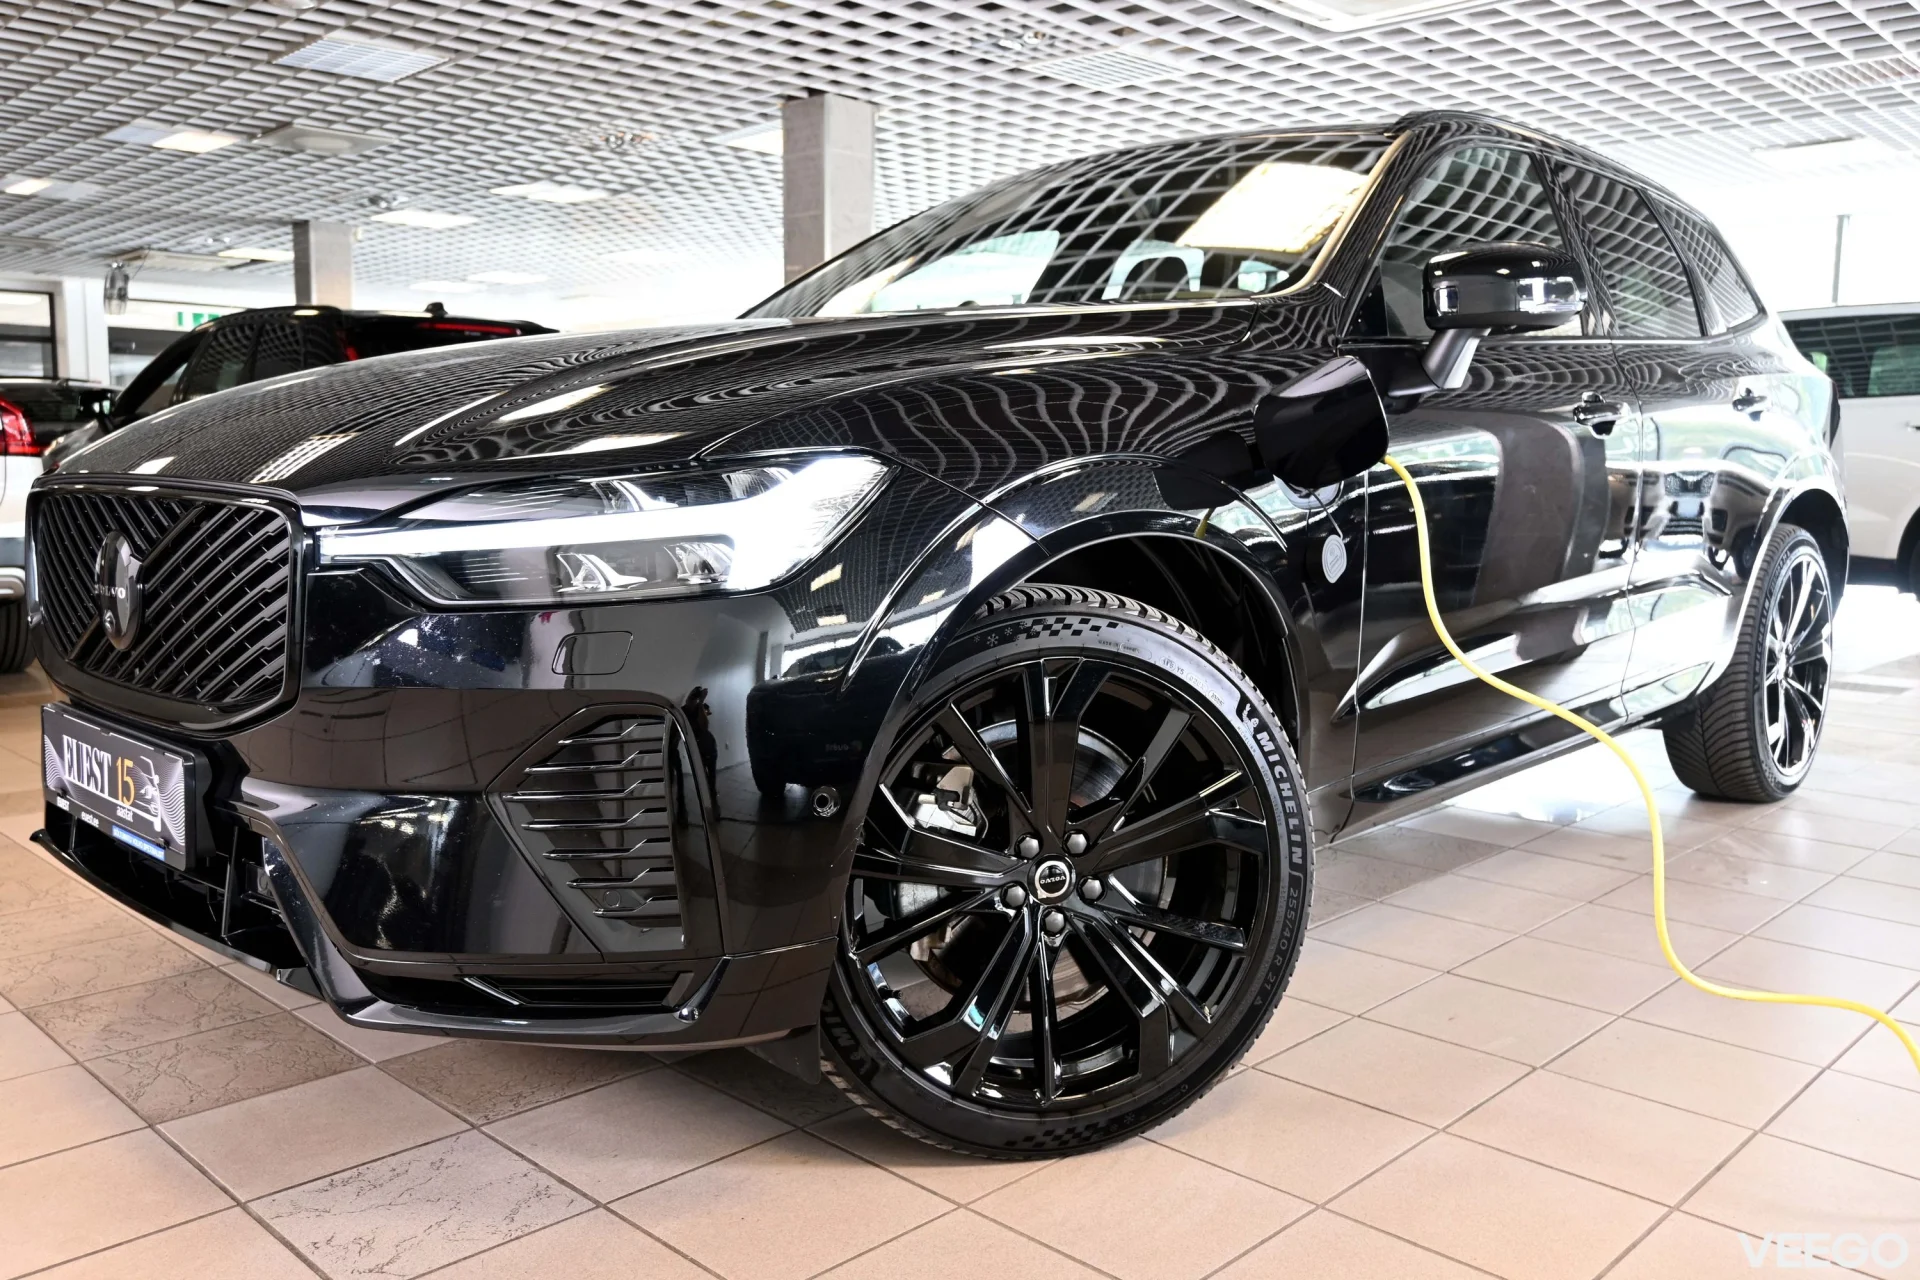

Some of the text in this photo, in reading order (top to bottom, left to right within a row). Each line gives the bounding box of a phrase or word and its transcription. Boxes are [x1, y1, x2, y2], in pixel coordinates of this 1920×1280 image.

[63, 734, 135, 807] EUEST 15
[1256, 731, 1302, 864] MICHELIN
[1040, 875, 1066, 884] VOLVO
[1279, 887, 1298, 949] 255/40
[1274, 954, 1283, 966] R
[1264, 972, 1276, 990] 21
